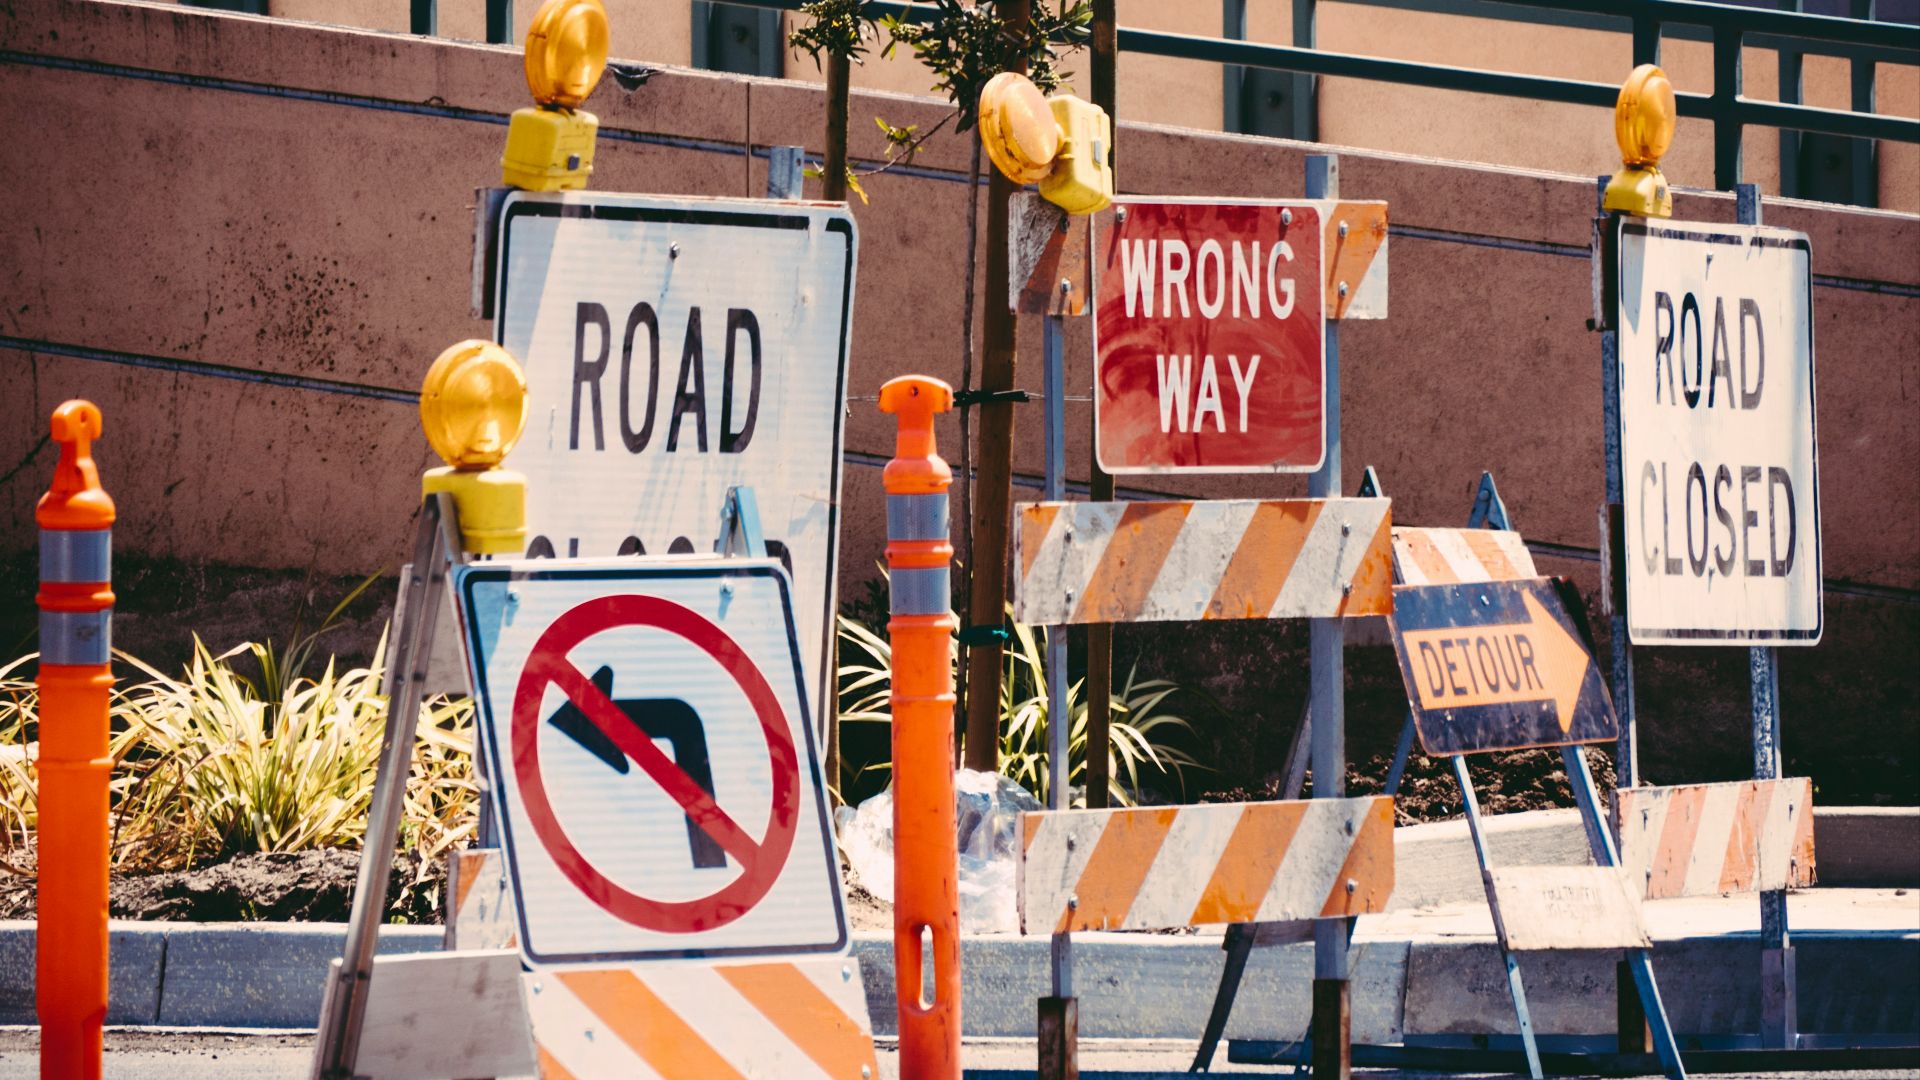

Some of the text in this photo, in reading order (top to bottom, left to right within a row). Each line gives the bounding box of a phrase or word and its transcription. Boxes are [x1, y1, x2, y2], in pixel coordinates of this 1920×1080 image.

[1120, 238, 1296, 320] WRONG
[569, 301, 762, 454] ROAD
[1156, 354, 1262, 433] WAY
[1654, 291, 1766, 410] ROAD
[1639, 459, 1797, 578] CLOSED
[1418, 633, 1544, 698] DETOUR
